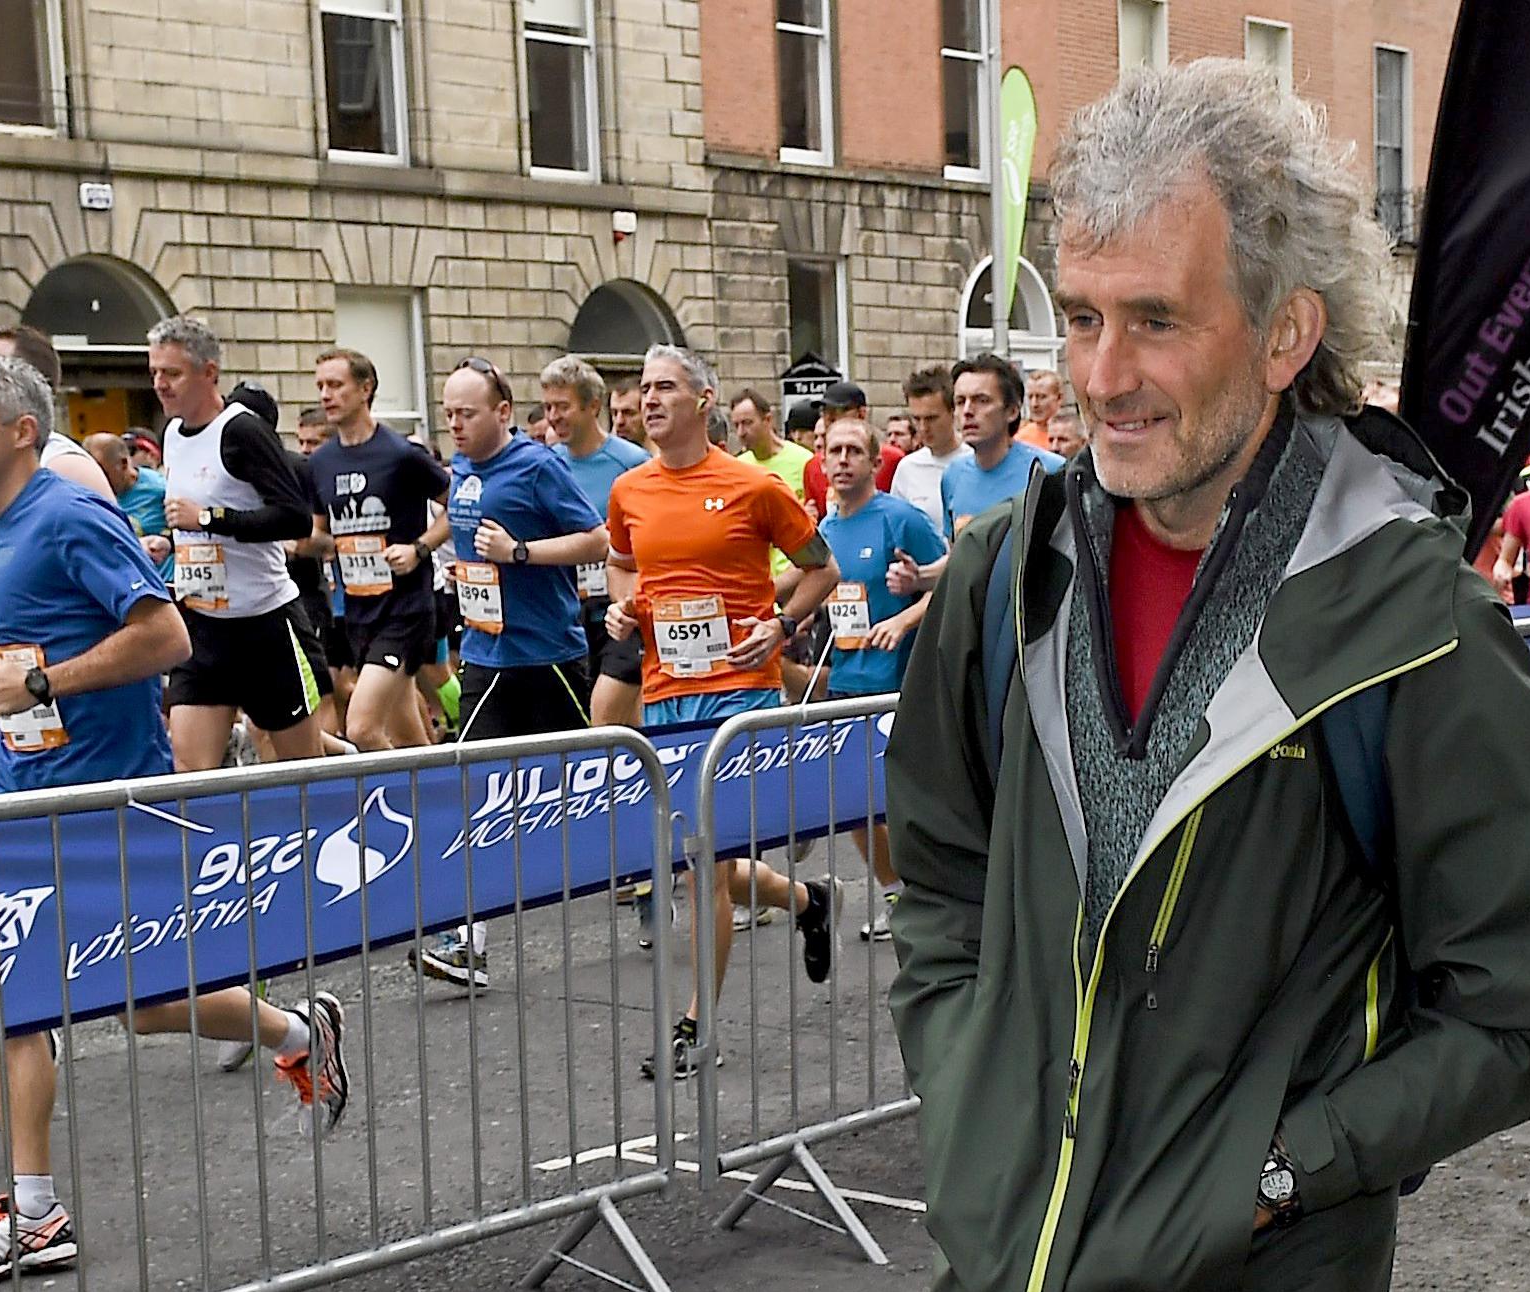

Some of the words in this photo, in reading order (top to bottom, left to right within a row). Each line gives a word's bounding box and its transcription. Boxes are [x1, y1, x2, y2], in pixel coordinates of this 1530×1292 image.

[795, 382, 808, 394] To
[810, 382, 828, 394] Let
[1439, 350, 1497, 424] Out
[668, 622, 711, 640] 6591
